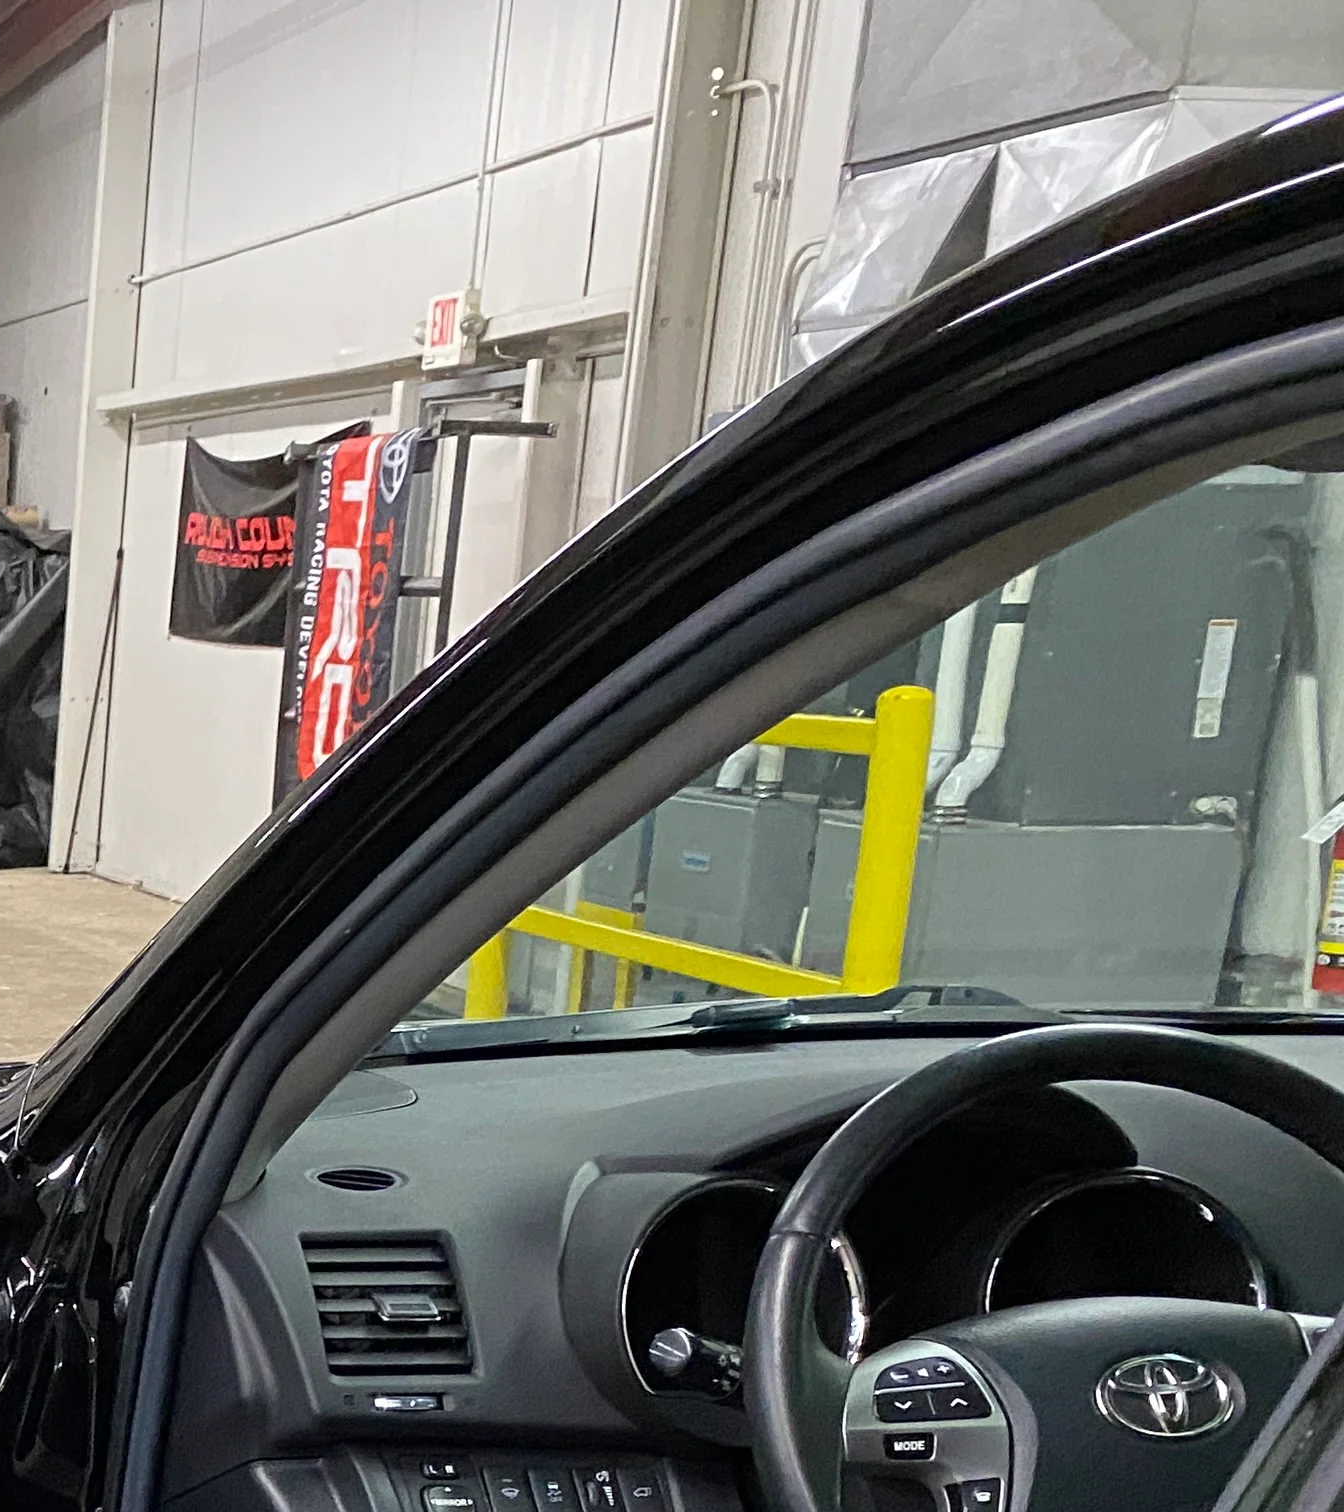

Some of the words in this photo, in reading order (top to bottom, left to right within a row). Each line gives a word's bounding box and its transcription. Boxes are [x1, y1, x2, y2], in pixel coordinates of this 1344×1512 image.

[431, 298, 458, 348] EXIT
[317, 444, 340, 512] OYOTA
[312, 436, 384, 768] TRD
[894, 1440, 926, 1451] MODE
